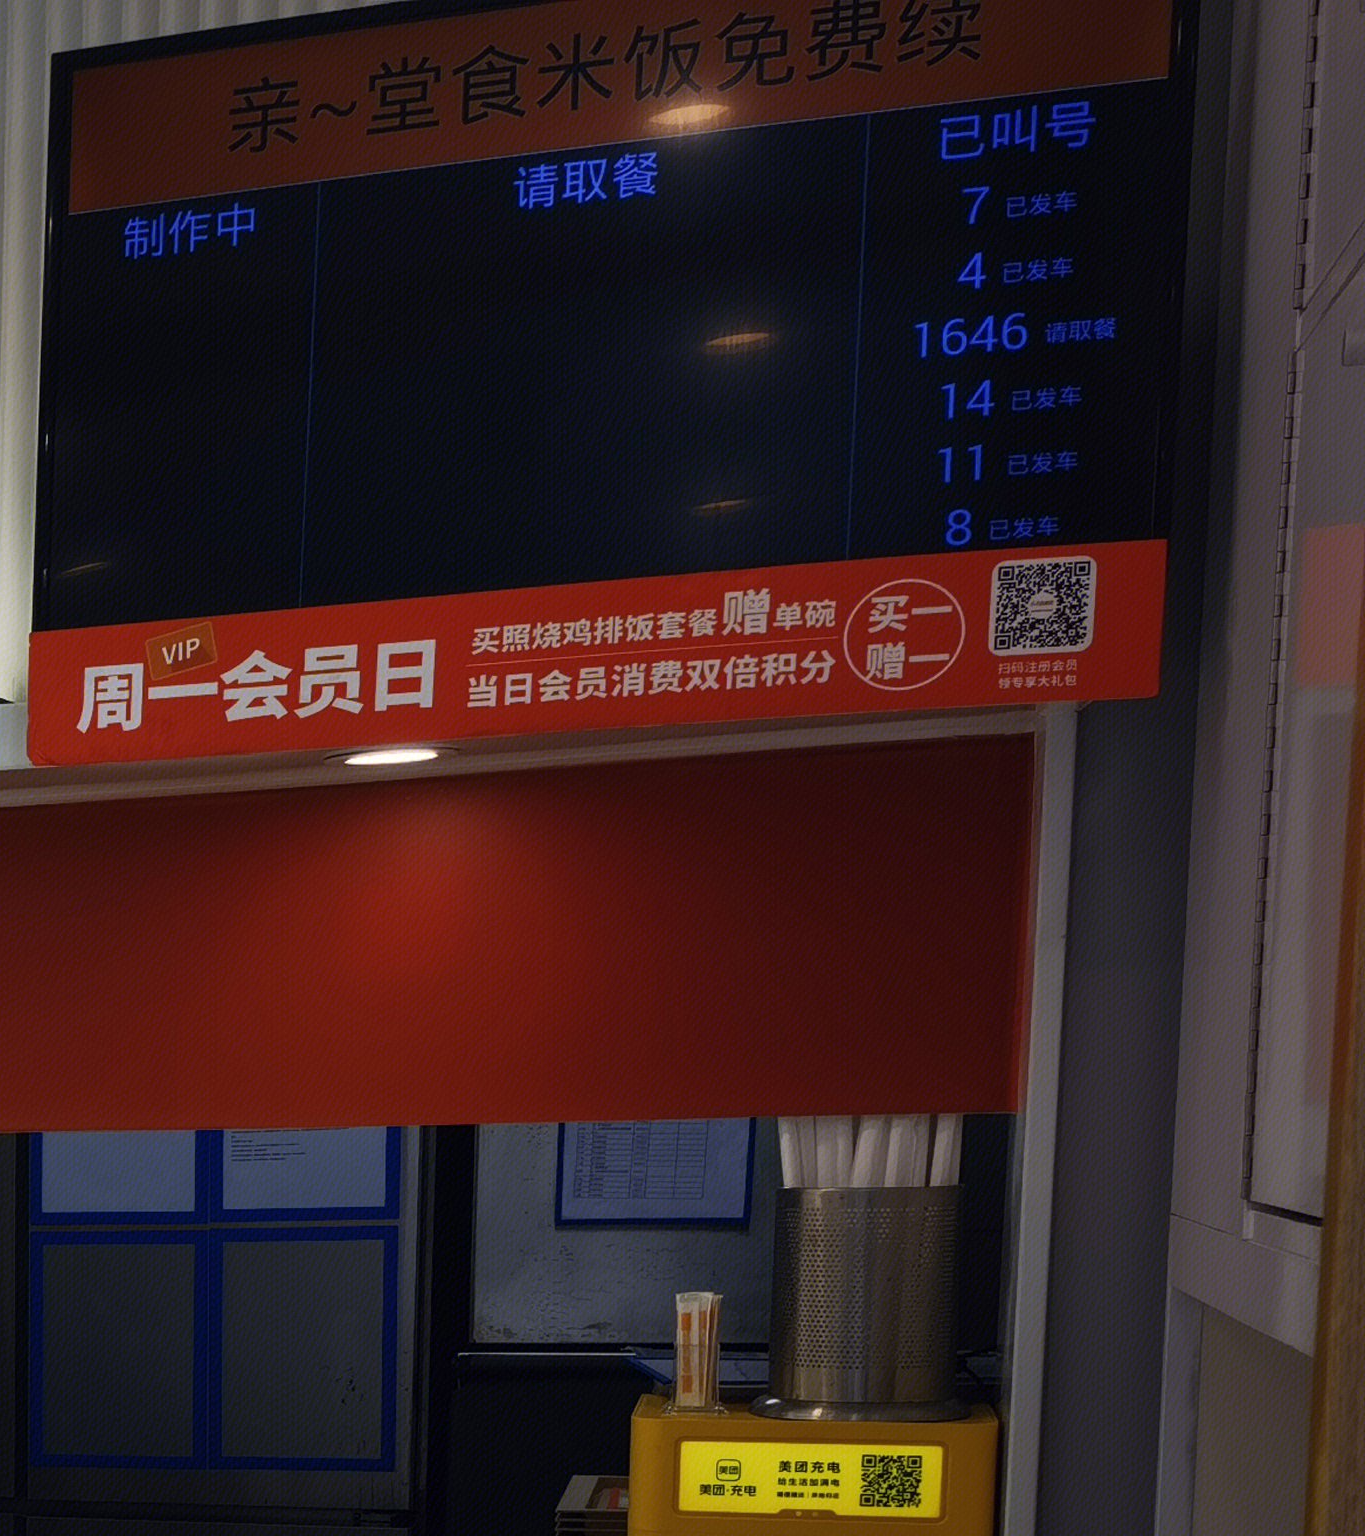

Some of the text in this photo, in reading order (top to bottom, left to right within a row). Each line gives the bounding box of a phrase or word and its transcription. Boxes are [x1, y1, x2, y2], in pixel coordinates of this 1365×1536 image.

[940, 101, 1097, 161] 已叫号
[514, 151, 659, 210] 请取餐
[963, 186, 1078, 225] 7 已发车
[124, 203, 256, 260] 制作中
[957, 252, 1074, 289] 4 已发车
[915, 312, 1117, 358] 1646 请取餐
[941, 379, 1083, 419] 14 已发车
[938, 444, 1079, 483] 11 已发车
[945, 509, 1060, 546] 8 已发车
[868, 595, 954, 634] 买一
[161, 637, 202, 666] VIP
[866, 641, 951, 681] 赠一
[76, 639, 437, 734] 周一会员日
[467, 650, 836, 708] 当日会员消费双倍积分
[778, 1460, 841, 1474] 美团充电
